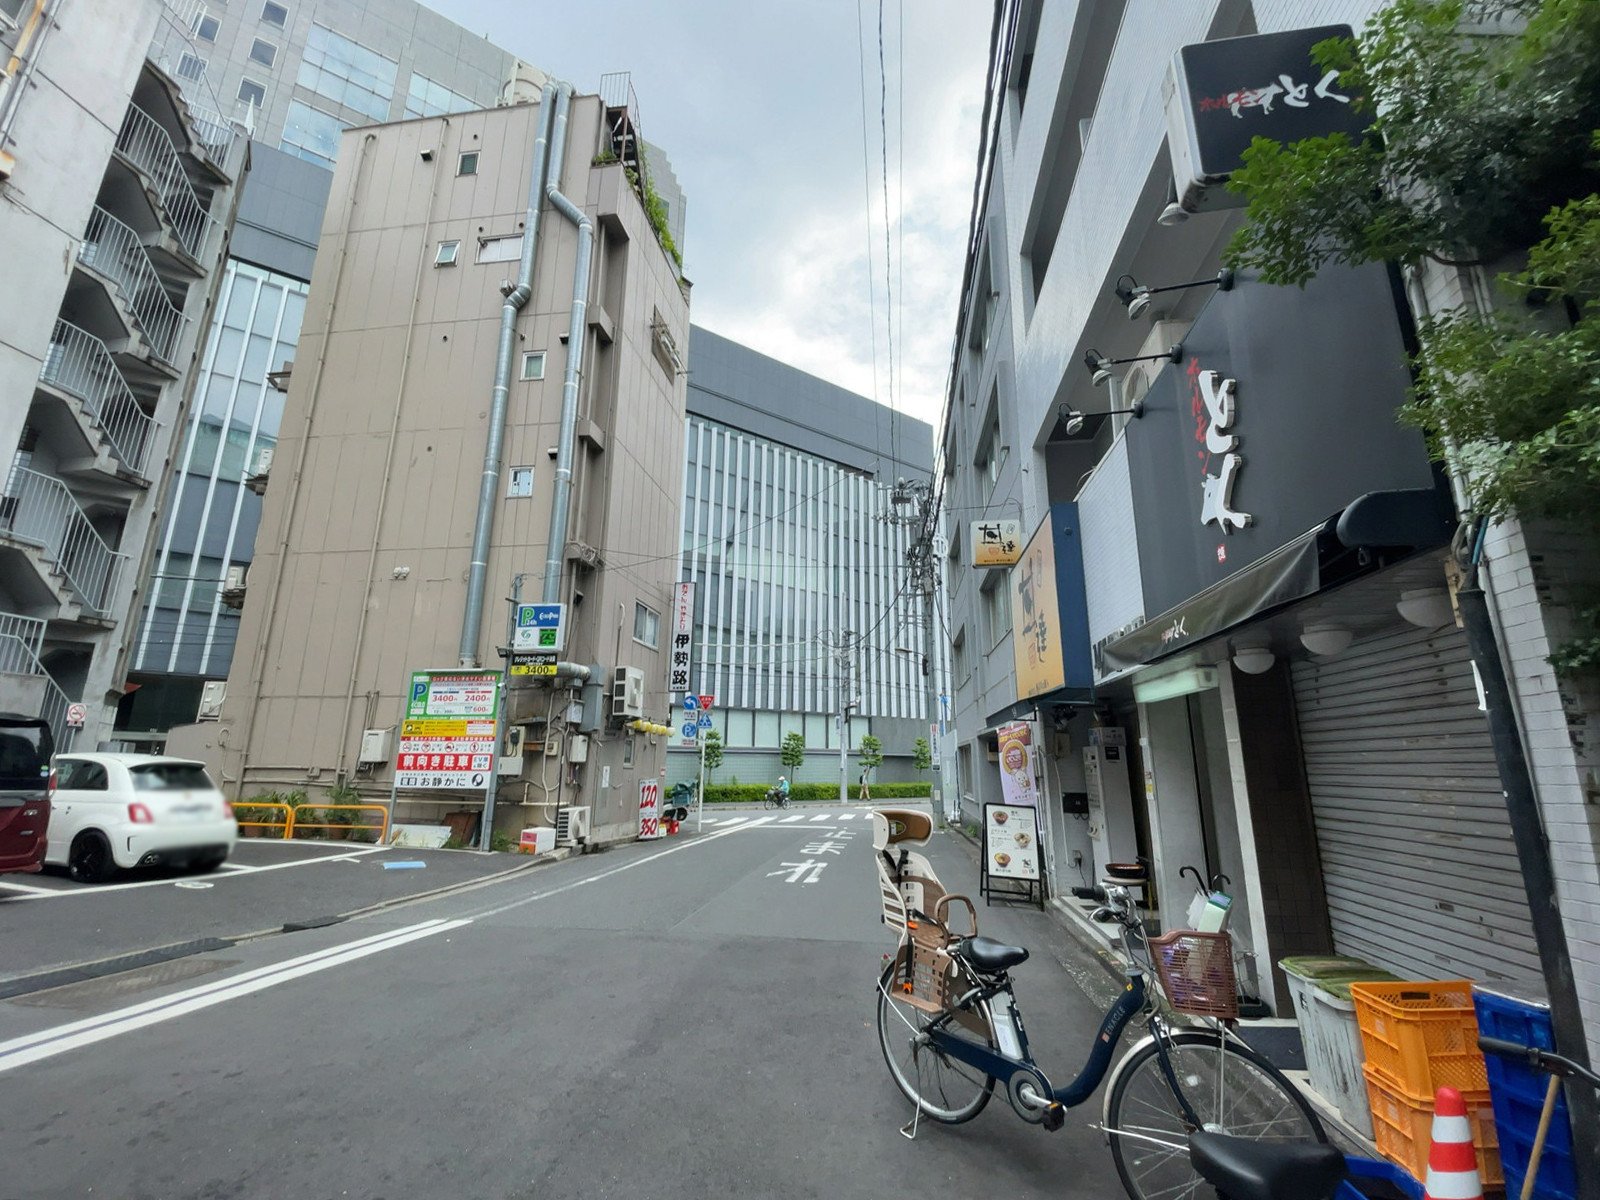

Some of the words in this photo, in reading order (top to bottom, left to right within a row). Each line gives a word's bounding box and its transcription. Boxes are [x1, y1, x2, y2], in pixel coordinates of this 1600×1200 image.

[1278, 69, 1351, 107] とく
[521, 607, 535, 626] P
[672, 634, 690, 685] 伊勢路
[413, 683, 426, 701] P
[403, 755, 469, 767] 前向き駐車
[420, 777, 466, 787] お静かに
[640, 785, 657, 808] 120
[640, 818, 657, 836] 350
[765, 827, 856, 883] 止まれ
